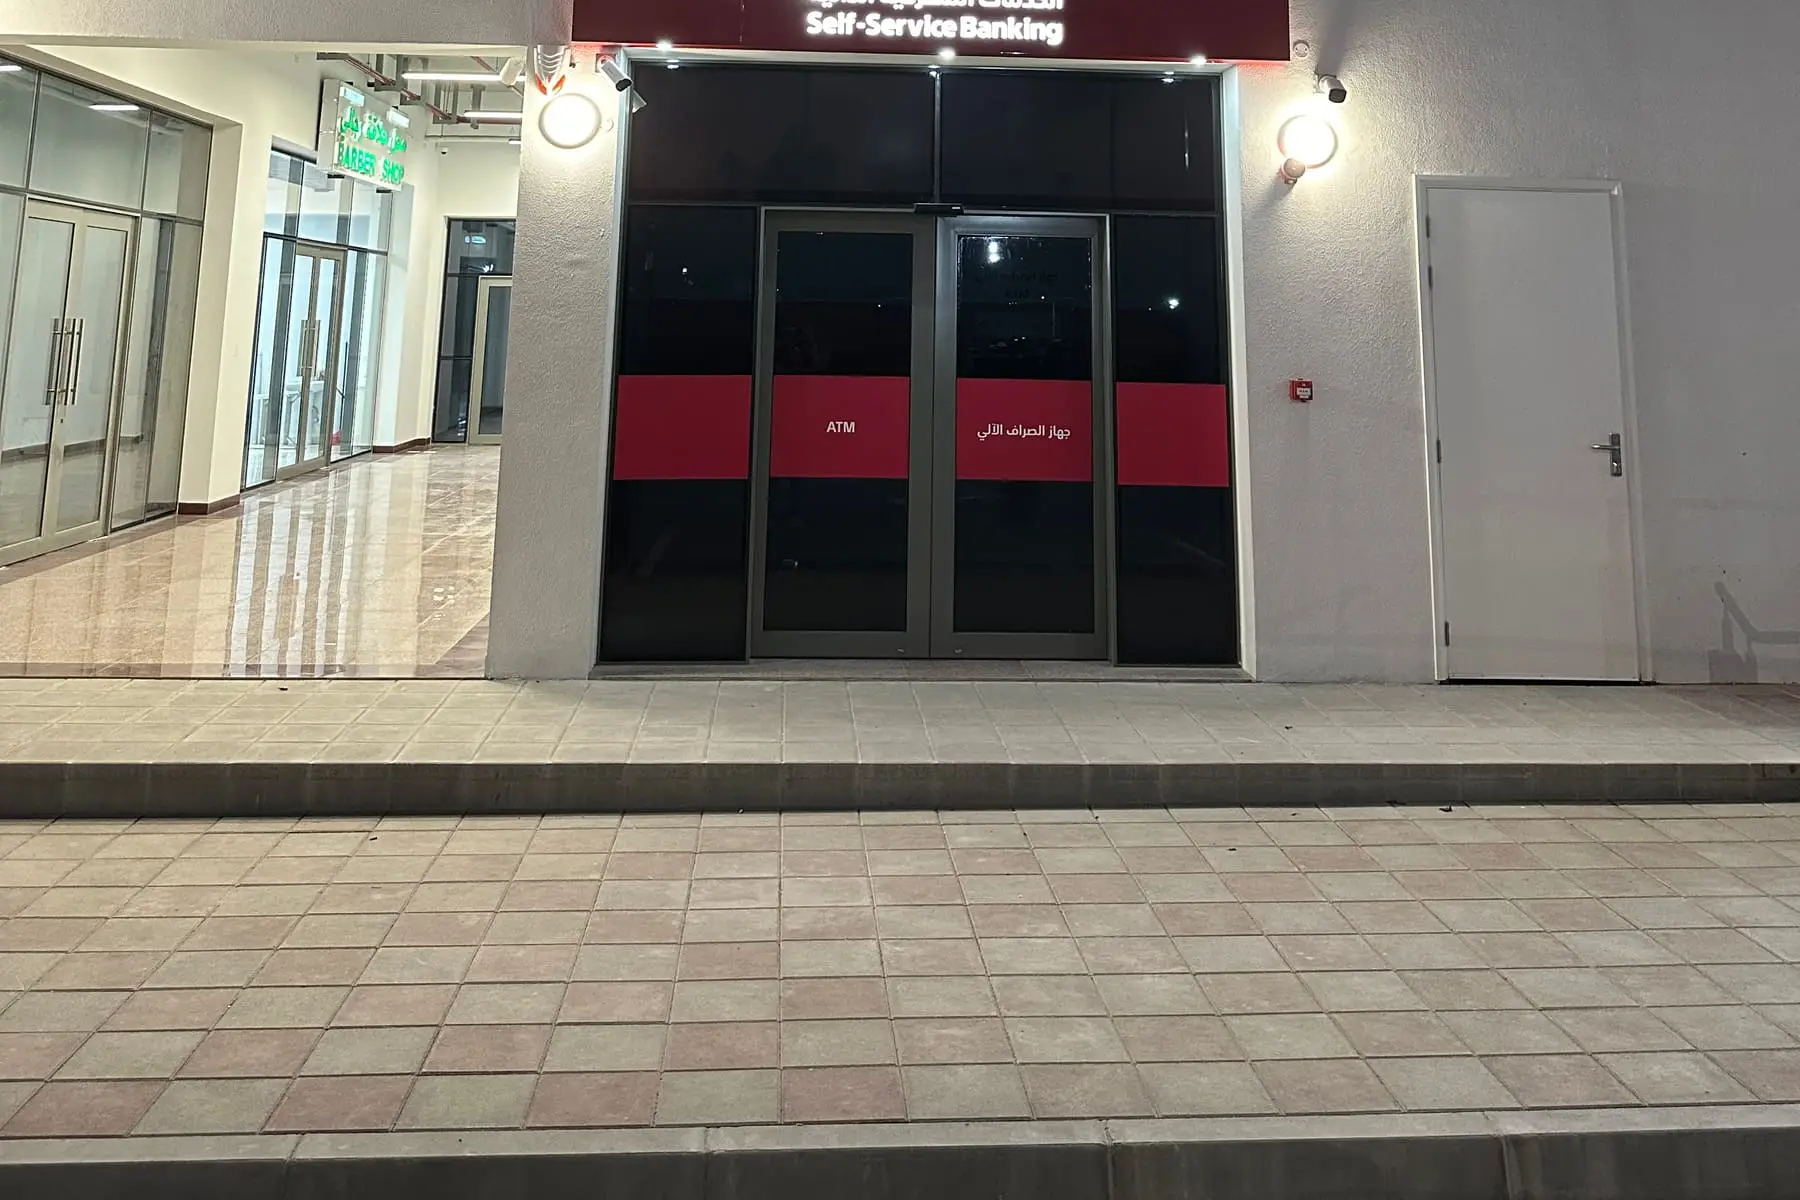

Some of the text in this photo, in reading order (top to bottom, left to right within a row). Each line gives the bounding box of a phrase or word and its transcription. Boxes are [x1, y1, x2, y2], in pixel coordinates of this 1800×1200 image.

[806, 11, 1064, 45] Self-Service Banking
[337, 141, 406, 184] BARBER SHOP
[826, 421, 856, 433] ATM
[976, 423, 1071, 441] جهاز الصراف الآلي
